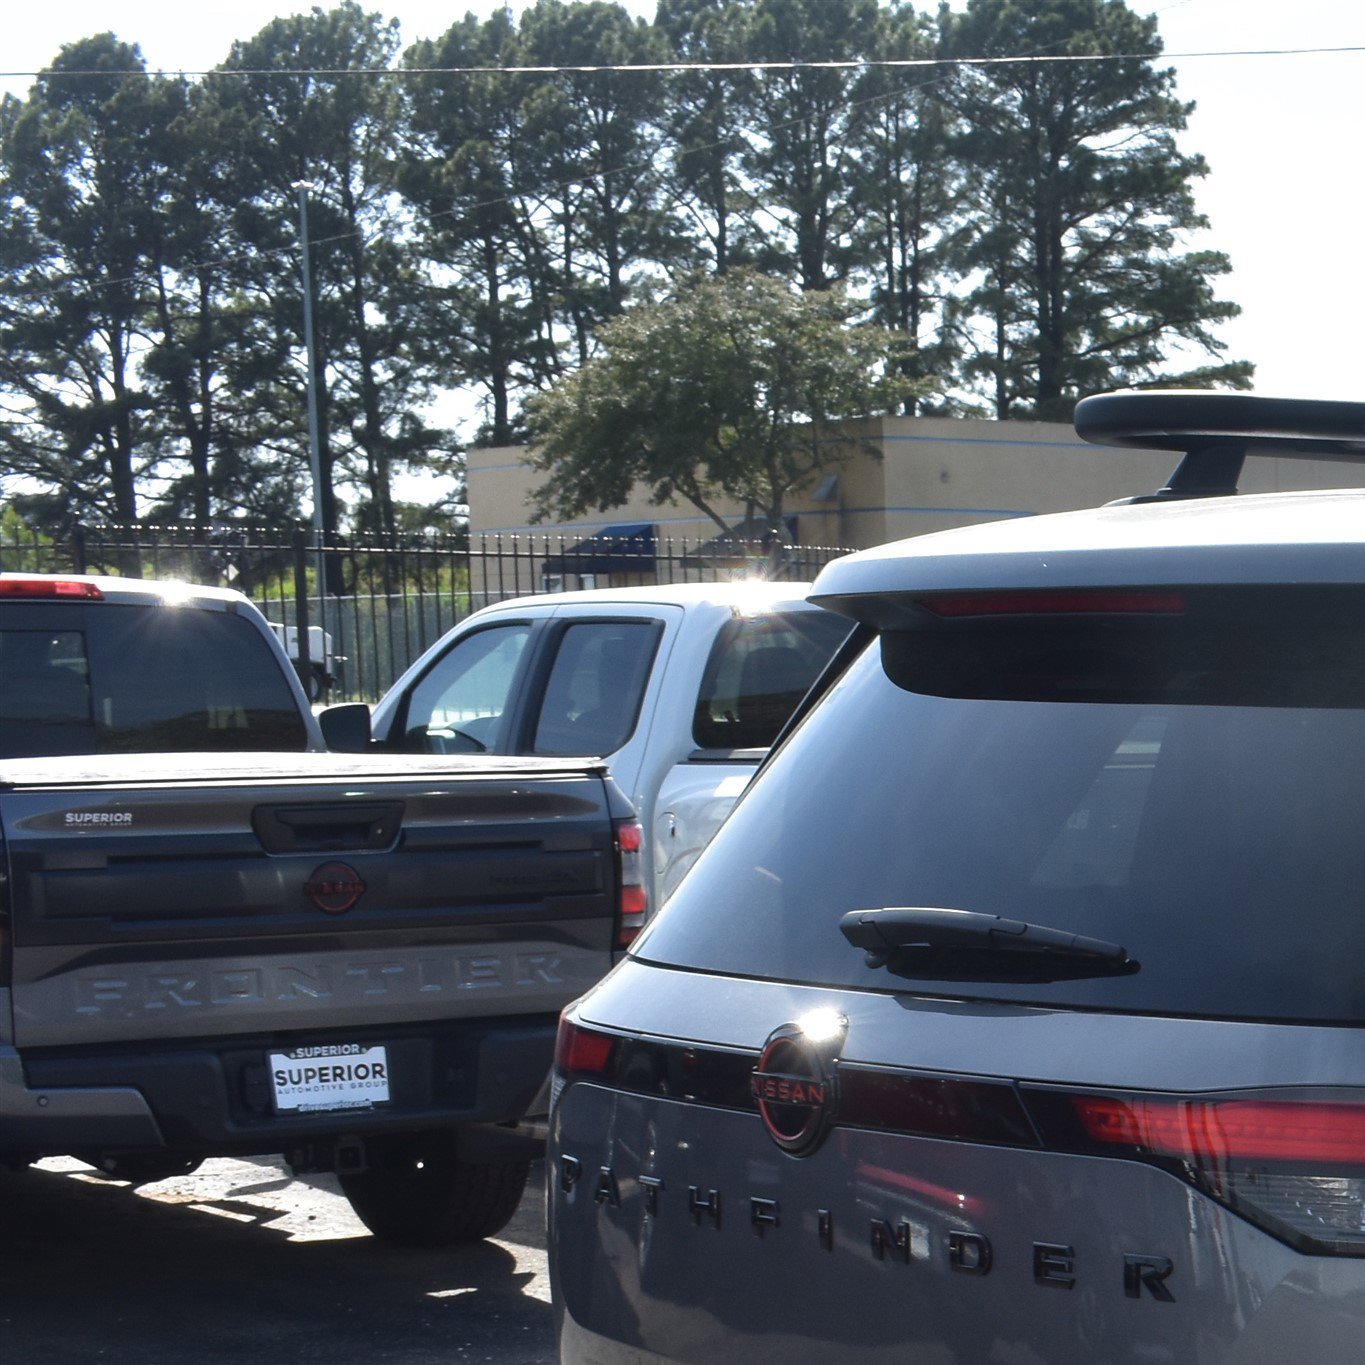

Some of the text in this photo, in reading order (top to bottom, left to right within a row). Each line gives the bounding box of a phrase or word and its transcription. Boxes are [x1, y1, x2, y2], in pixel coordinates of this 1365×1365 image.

[65, 812, 132, 823] SUPERIOR
[296, 1044, 360, 1058] SUPERIOR
[274, 1062, 388, 1087] SUPERIOR
[278, 1080, 388, 1095] AUTOMOTIVE GROUP
[560, 1154, 1177, 1303] PATHFINDER
